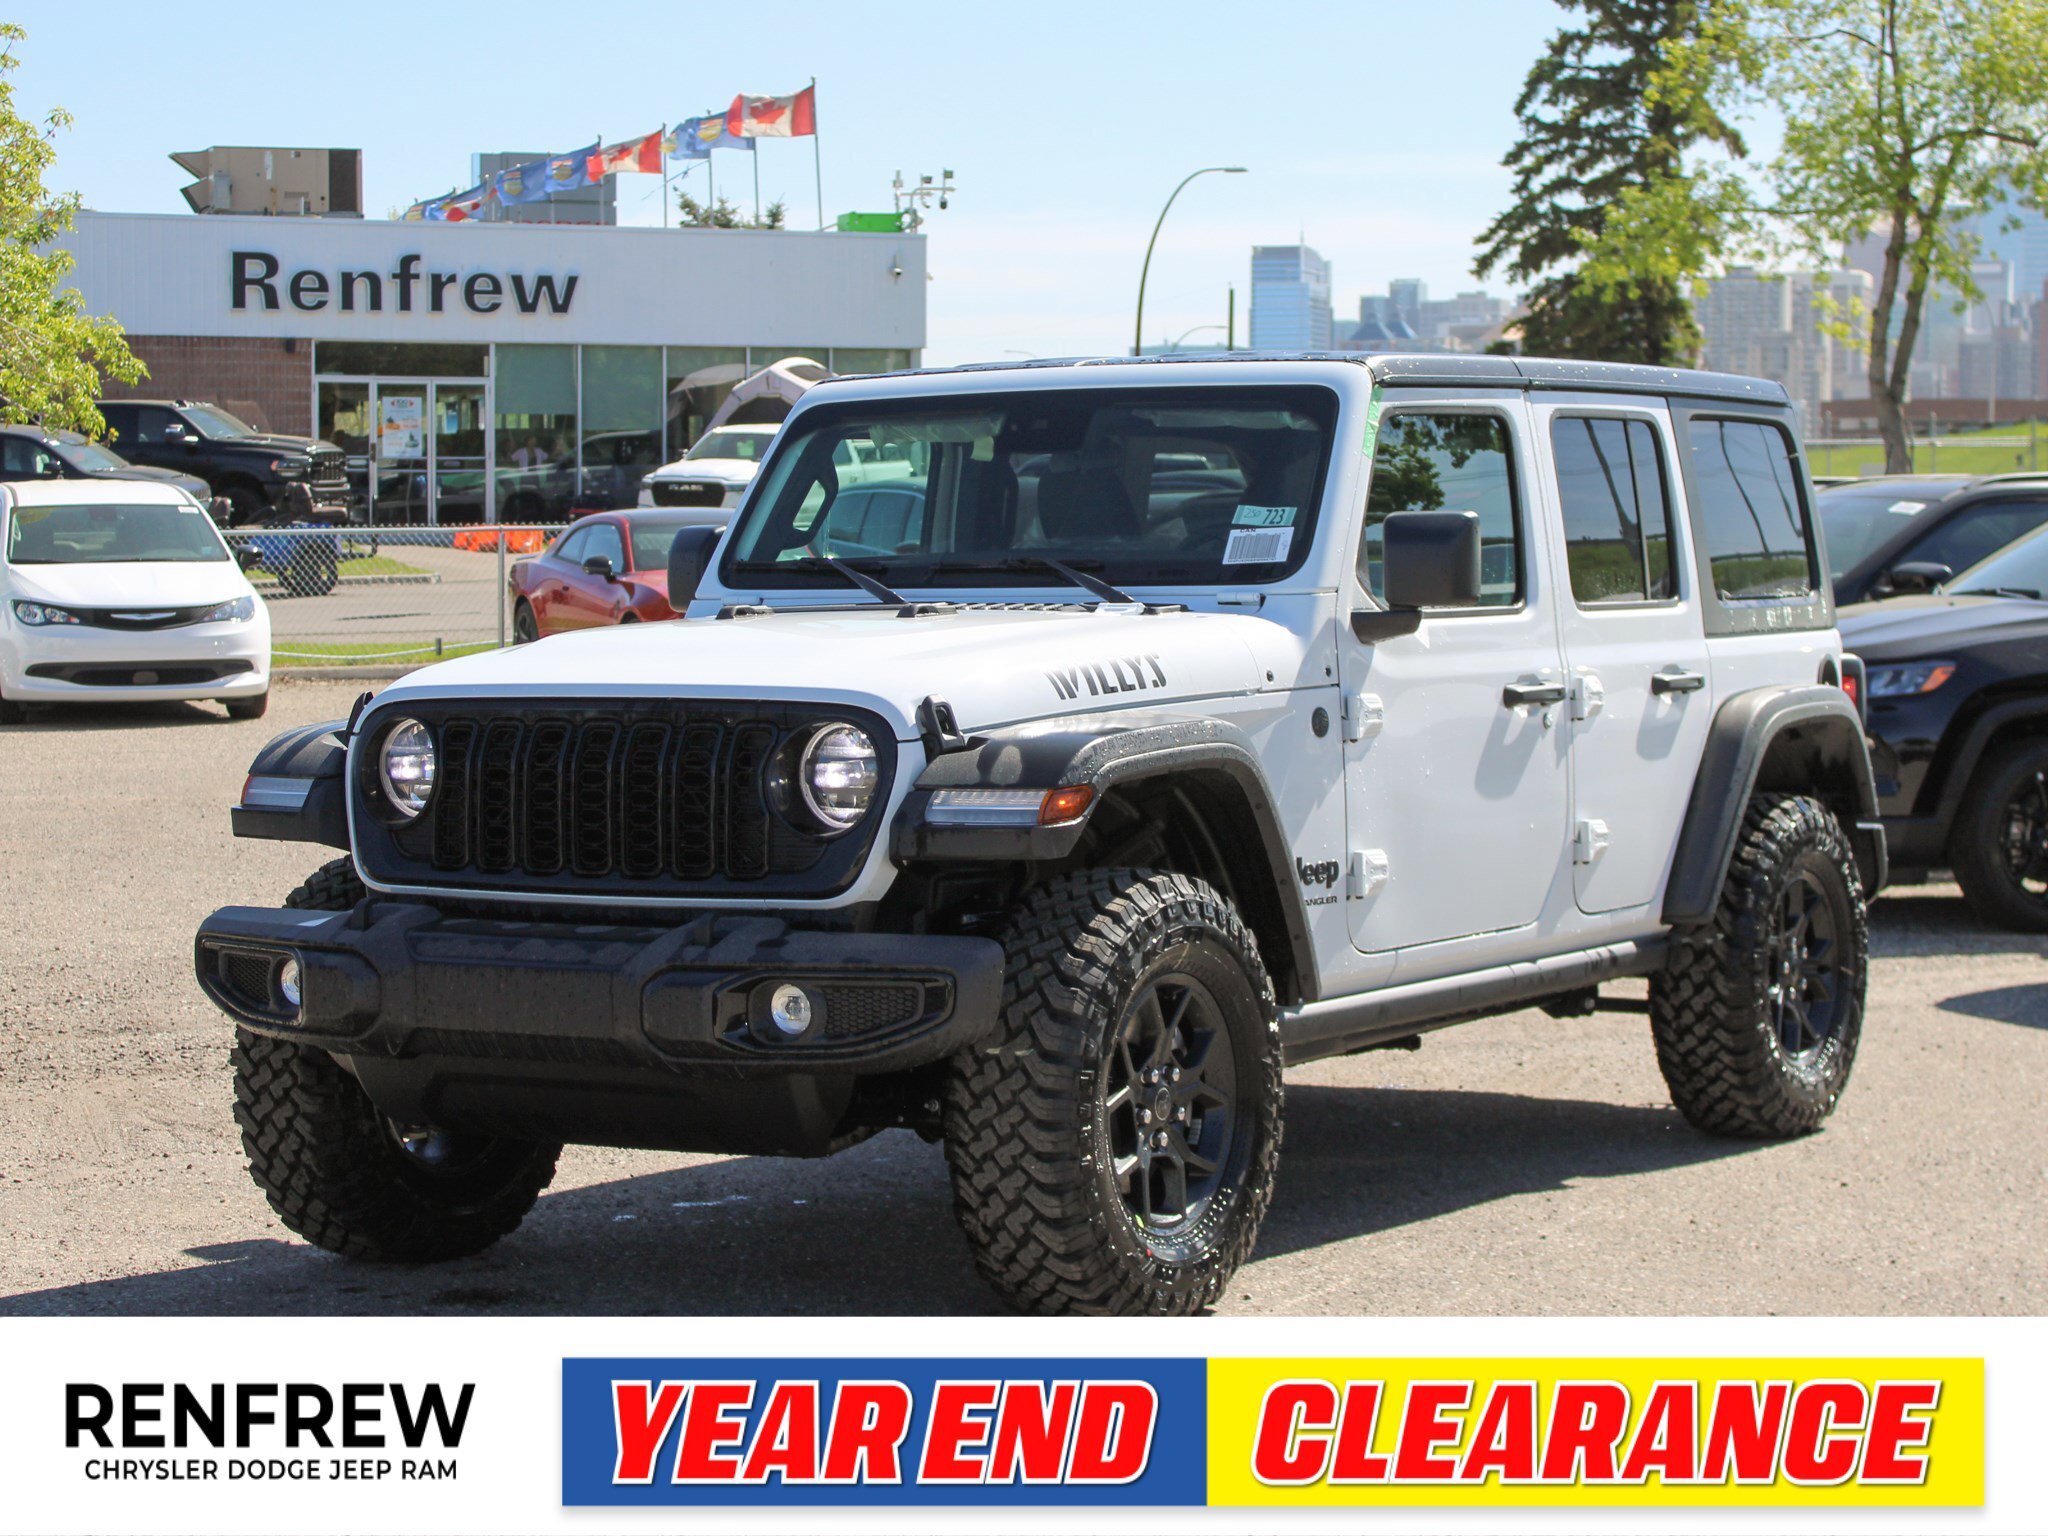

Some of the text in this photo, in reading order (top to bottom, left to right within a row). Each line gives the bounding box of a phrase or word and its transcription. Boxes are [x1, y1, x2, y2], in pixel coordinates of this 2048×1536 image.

[231, 251, 579, 314] Renfrew
[1262, 508, 1286, 525] 723
[1042, 652, 1167, 700] WILLYS
